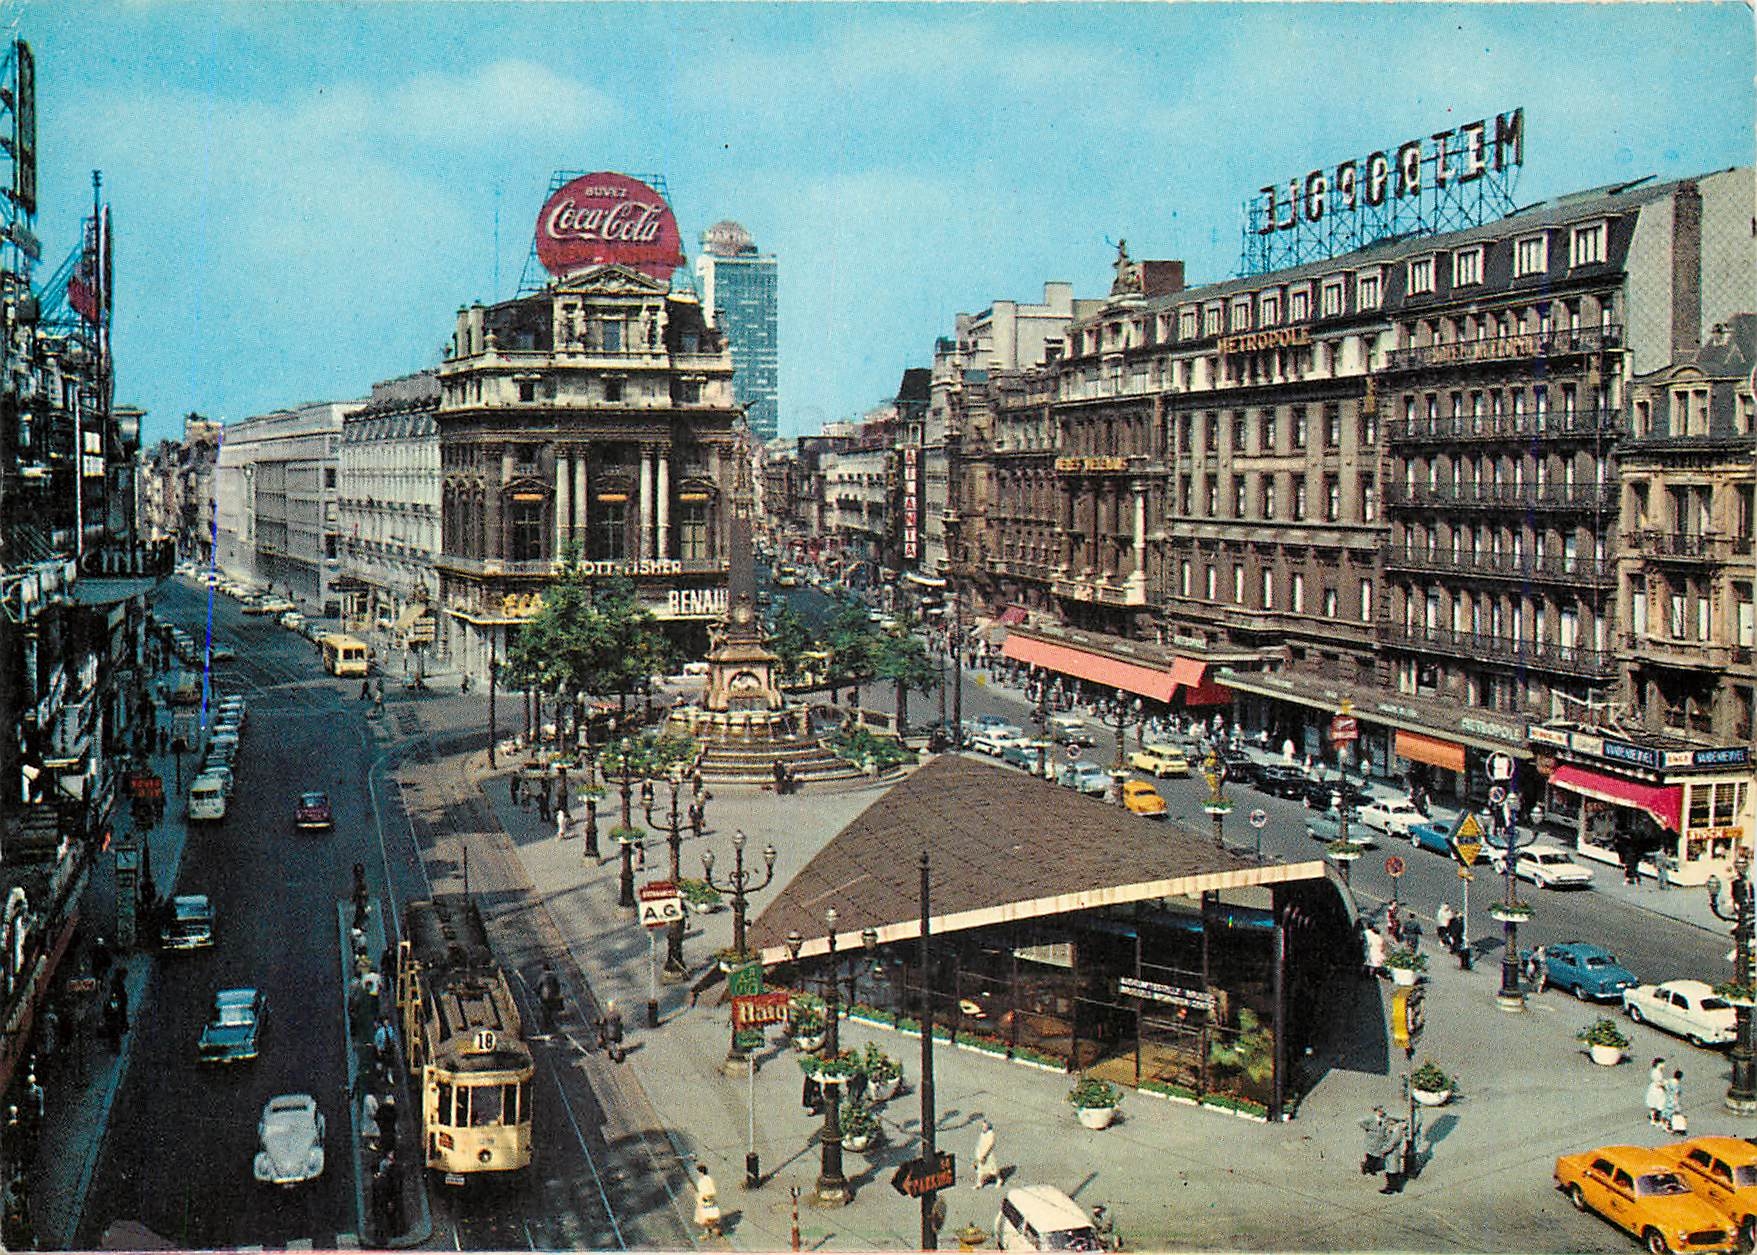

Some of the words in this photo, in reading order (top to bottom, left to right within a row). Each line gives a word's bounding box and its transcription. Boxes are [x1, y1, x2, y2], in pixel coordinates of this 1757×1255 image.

[547, 199, 662, 242] Coca-Cola
[1217, 327, 1312, 354] METROPOLE
[904, 450, 916, 557] ATLANTA
[477, 1033, 493, 1050] 18
